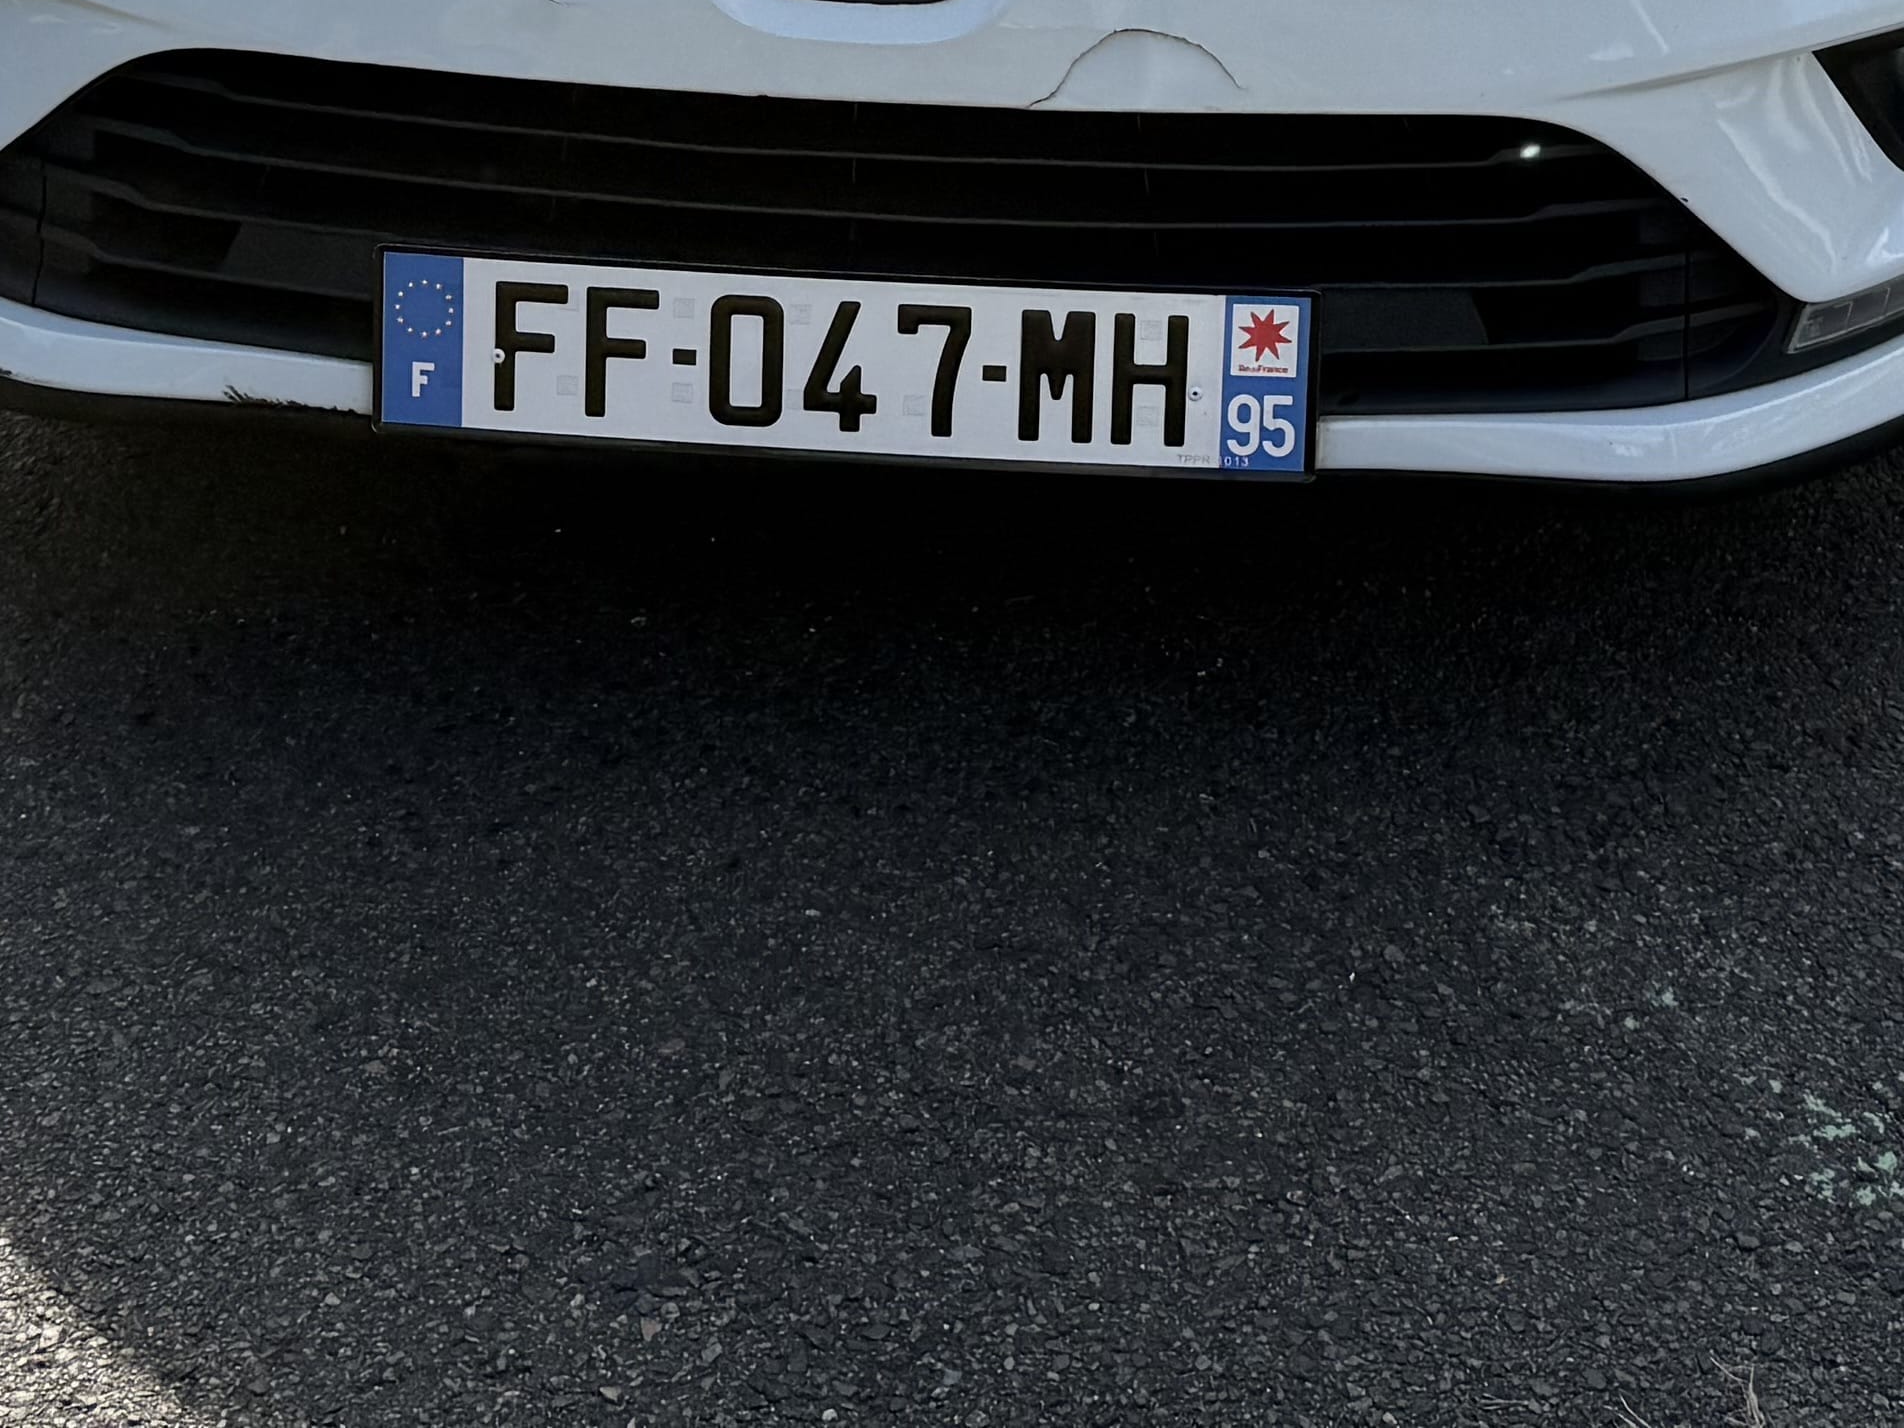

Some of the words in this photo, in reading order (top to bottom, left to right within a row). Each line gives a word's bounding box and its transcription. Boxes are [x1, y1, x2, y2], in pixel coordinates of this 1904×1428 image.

[411, 361, 436, 398] F
[494, 280, 1190, 448] FF-047-MH
[1226, 393, 1296, 458] 95
